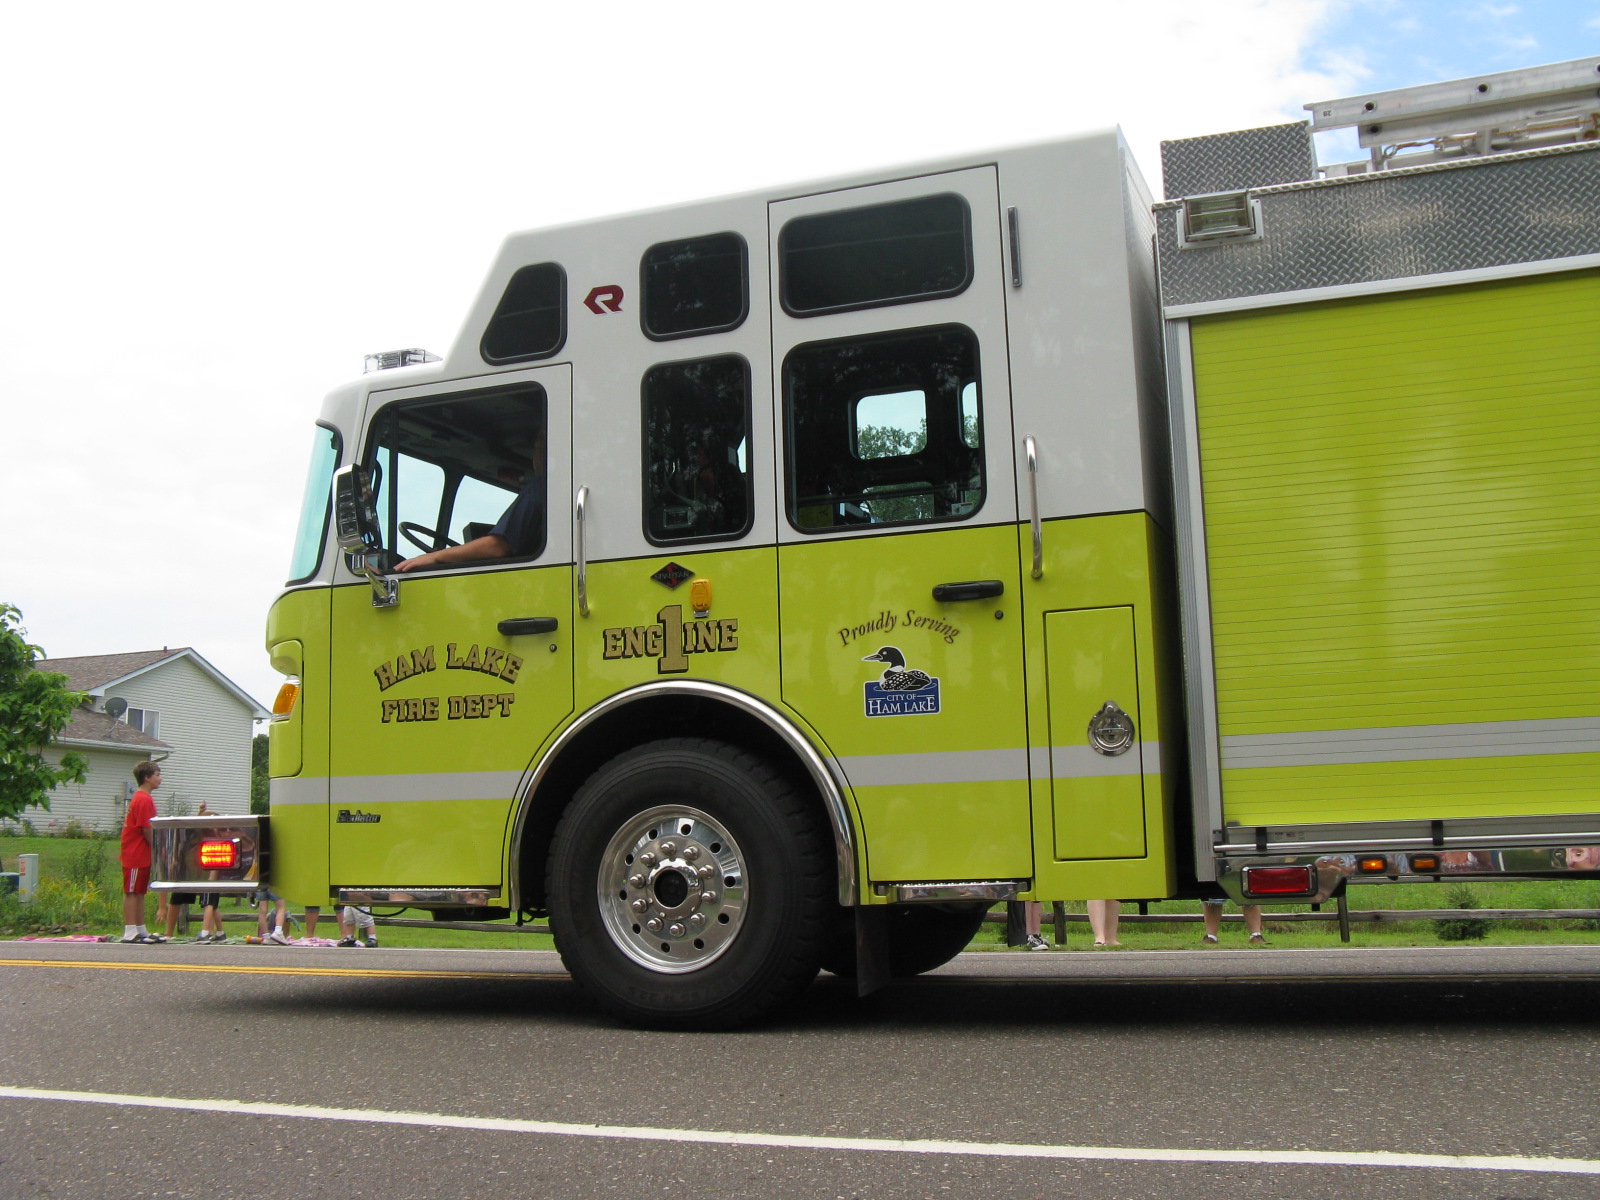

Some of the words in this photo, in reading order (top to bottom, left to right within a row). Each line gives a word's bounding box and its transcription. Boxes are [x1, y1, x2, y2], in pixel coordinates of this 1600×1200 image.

[838, 610, 897, 648] Proudly
[902, 609, 961, 645] Serving
[373, 645, 436, 692] HAM
[446, 643, 523, 684] LAKE
[382, 697, 439, 723] FIRE
[448, 693, 515, 719] DEPT
[868, 699, 901, 715] HAM
[904, 696, 937, 713] LAKE
[886, 694, 905, 702] CITY
